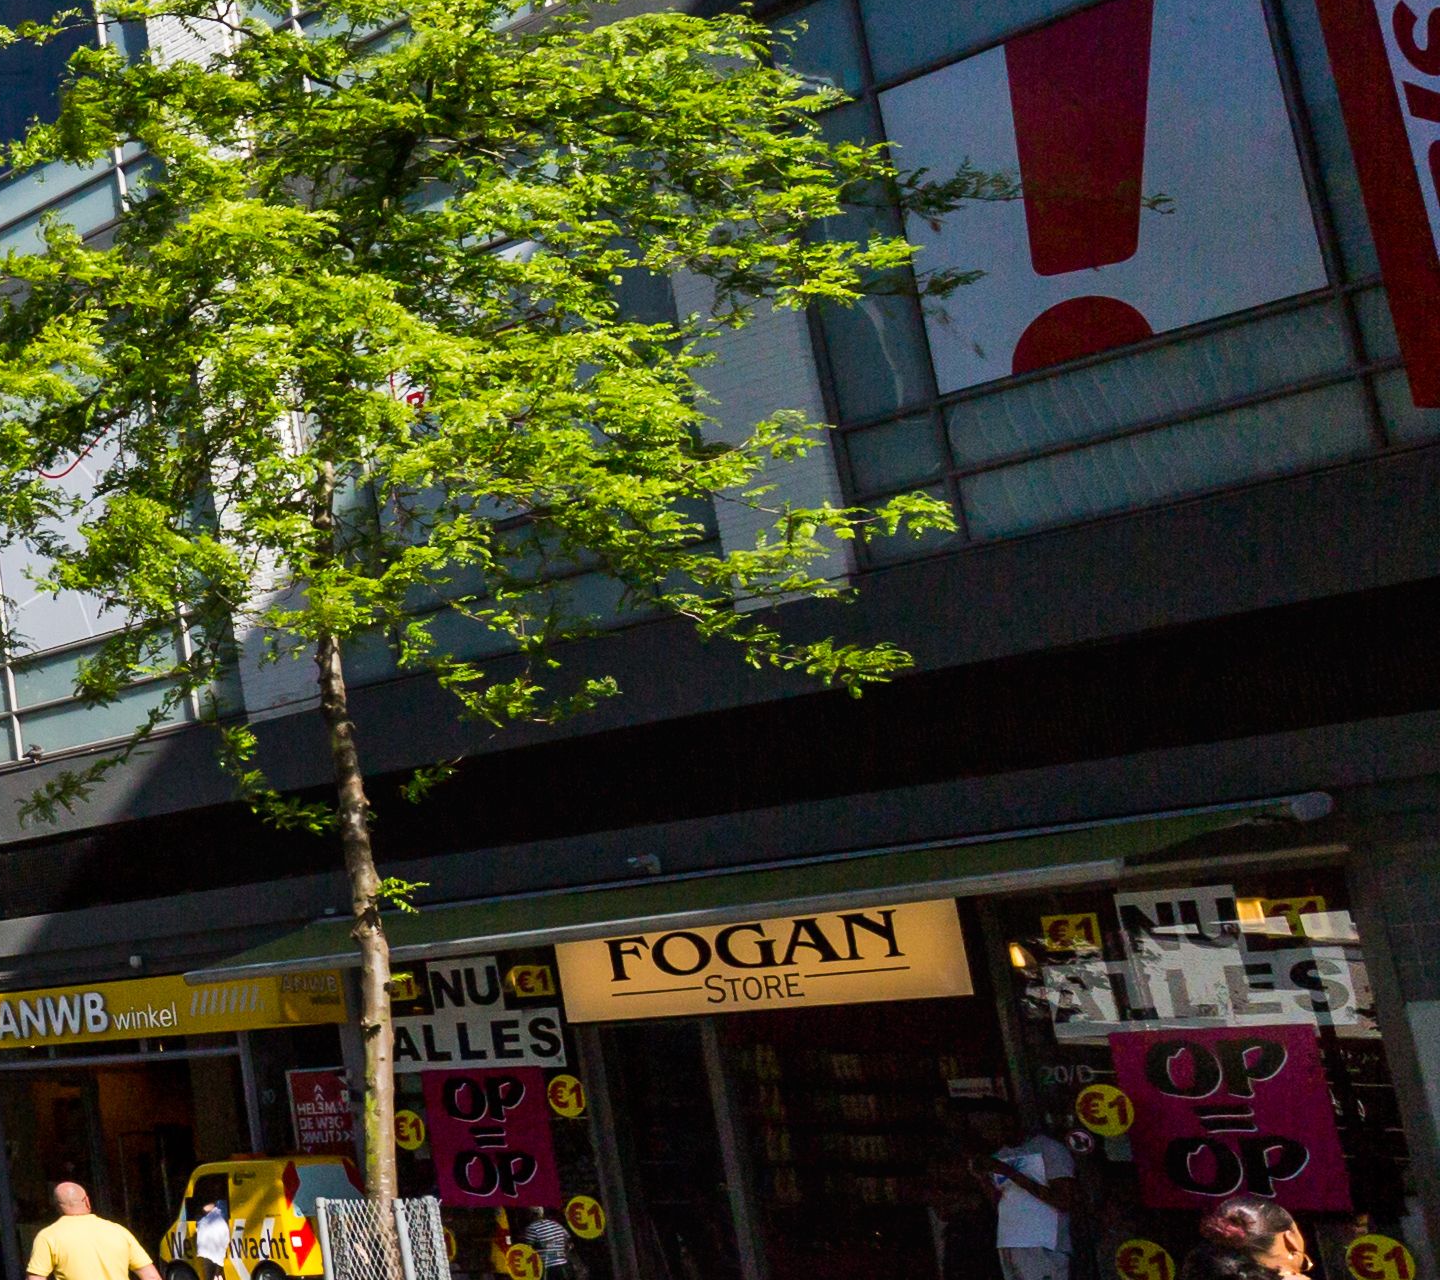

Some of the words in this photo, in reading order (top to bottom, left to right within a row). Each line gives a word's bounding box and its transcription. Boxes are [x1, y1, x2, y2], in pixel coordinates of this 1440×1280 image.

[1047, 917, 1096, 946] €1
[1119, 897, 1241, 952] NU
[603, 908, 906, 983] FOGAN
[430, 965, 501, 1009] NU
[517, 970, 551, 993] €1
[706, 972, 805, 1005] STORE
[112, 1001, 178, 1031] winkel
[392, 1016, 562, 1063] ALLES
[1145, 1038, 1288, 1099] OP
[442, 1074, 526, 1122] OP
[549, 1080, 584, 1111] €1
[1078, 1091, 1131, 1128] €1
[396, 1117, 423, 1143] €1
[453, 1151, 538, 1198] OP
[1162, 1135, 1310, 1198] OP
[567, 1201, 604, 1233] €1
[506, 1250, 540, 1279] €1
